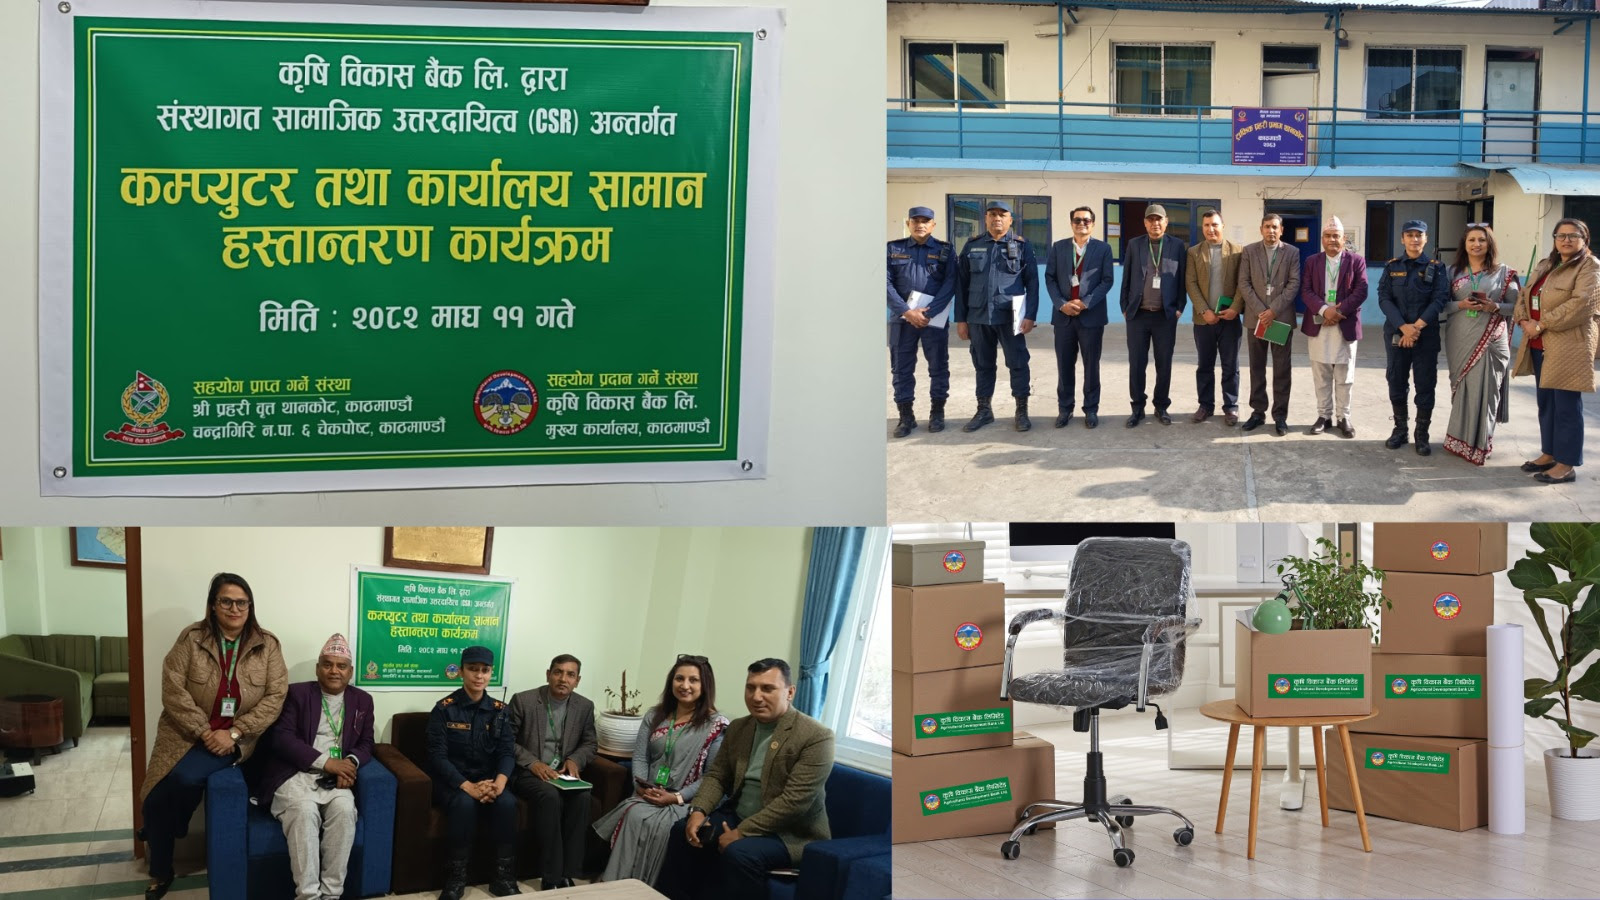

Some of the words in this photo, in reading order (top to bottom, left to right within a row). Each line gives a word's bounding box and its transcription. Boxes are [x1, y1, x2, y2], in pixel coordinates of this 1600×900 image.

[279, 53, 330, 93] कृषि
[340, 55, 415, 90] विकास
[474, 57, 508, 91] लि.
[521, 67, 568, 96] द्वारा
[157, 99, 262, 132] संस्थागत
[272, 99, 383, 132] सामाजिक
[392, 101, 519, 134] उत्तरदायित्व
[528, 108, 579, 135] (CSR)
[590, 105, 678, 136] अन्तर्गत
[120, 167, 299, 220] कम्प्युटर
[315, 168, 391, 208] तथा
[407, 158, 573, 209] कार्यालय
[588, 171, 708, 212] सामान
[218, 225, 434, 269] हस्तान्तरण
[449, 215, 614, 267] कार्यक्रम
[259, 299, 320, 333] मिति
[352, 306, 418, 330] २०८२
[431, 305, 482, 329] माघ
[493, 305, 524, 328] ११
[536, 298, 576, 329] गते
[193, 377, 244, 395] सहयोग
[250, 379, 281, 394] प्राप्त
[286, 375, 310, 392] गर्ने
[315, 376, 351, 393] संस्था
[547, 370, 593, 387] सहयोग
[600, 372, 633, 388] प्रदान
[638, 369, 660, 385] गर्ने
[665, 370, 699, 386] संस्था
[193, 399, 211, 417] श्री
[217, 399, 251, 417] प्रहरी
[282, 397, 340, 416] थानकोट,
[546, 391, 580, 416] कृषि
[586, 391, 636, 412] विकास
[674, 390, 698, 410] लि.
[192, 421, 257, 440] चन्द्रागिरि
[301, 424, 310, 438] ६
[546, 423, 578, 439] मुख्य
[583, 420, 642, 437] कार्यालय,
[411, 612, 429, 624] तथा
[432, 611, 471, 627] कार्यालय
[473, 616, 500, 628] सामान
